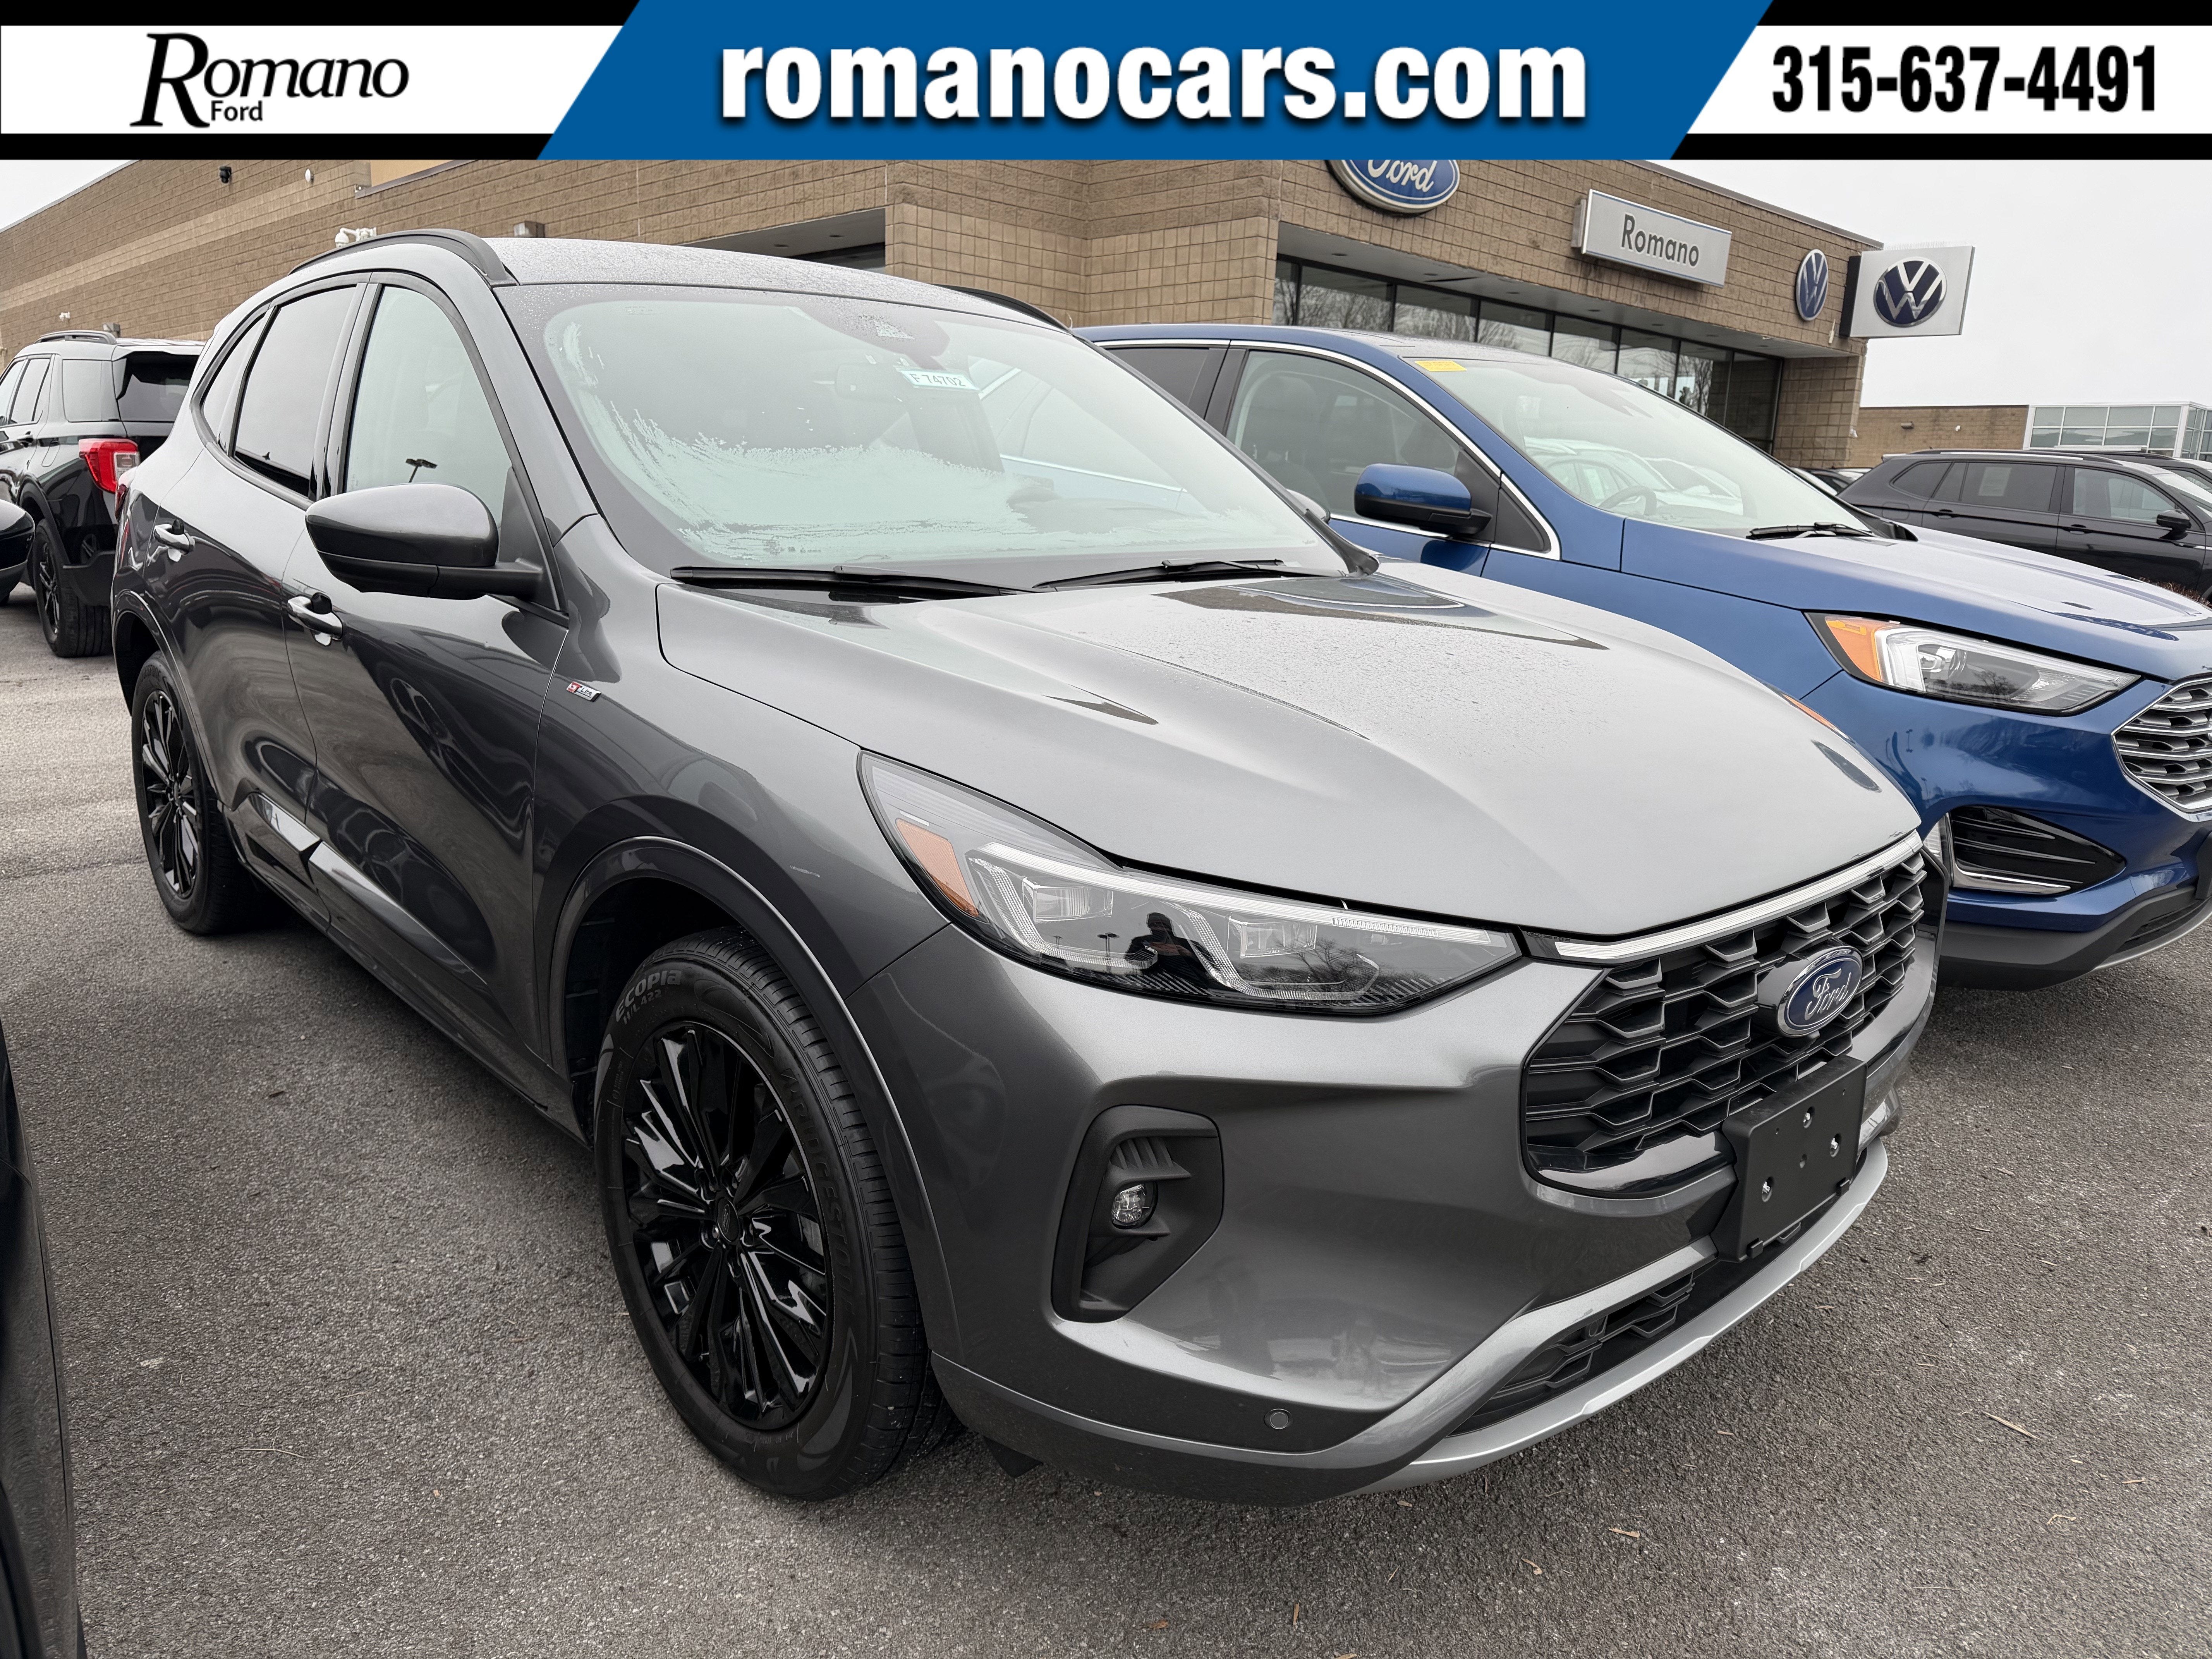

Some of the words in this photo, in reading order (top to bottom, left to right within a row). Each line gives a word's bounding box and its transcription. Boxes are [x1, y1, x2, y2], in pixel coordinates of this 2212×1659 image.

[1621, 213, 1699, 267] Romano
[641, 989, 662, 1006] 422
[1804, 968, 1852, 1021] Ford
